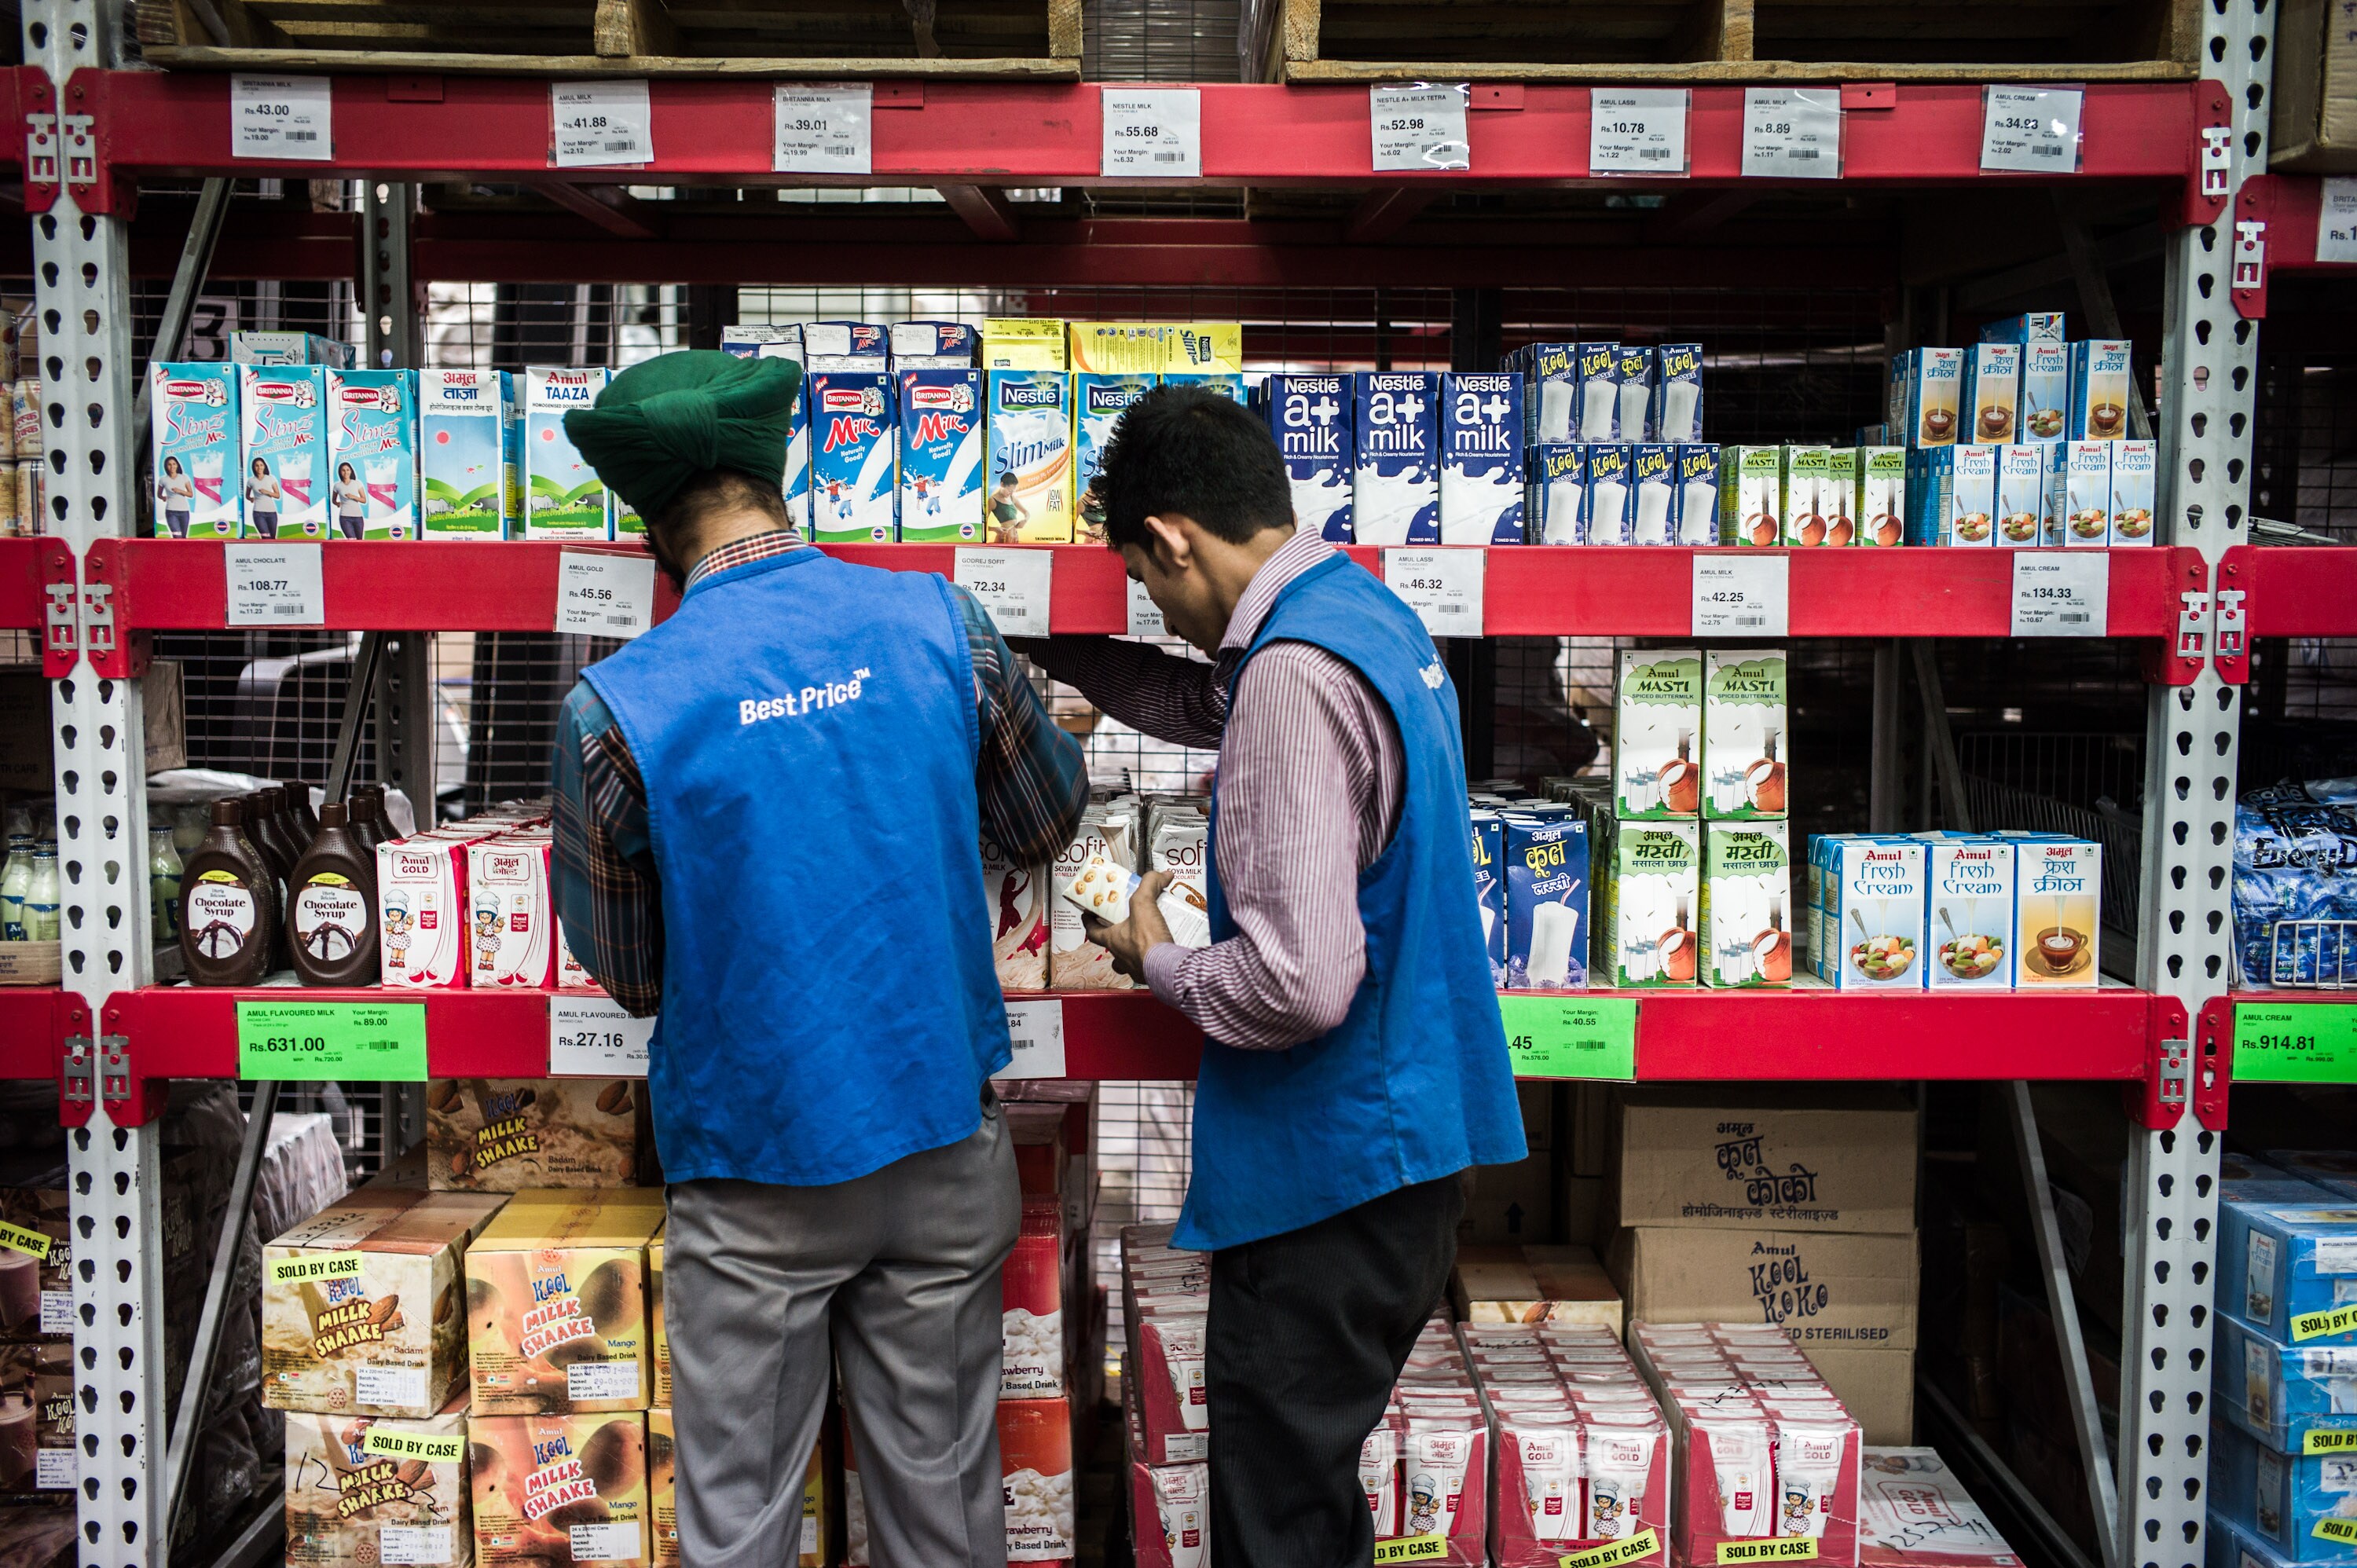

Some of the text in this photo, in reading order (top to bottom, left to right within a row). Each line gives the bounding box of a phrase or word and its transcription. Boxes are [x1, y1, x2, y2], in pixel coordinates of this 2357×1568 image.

[245, 104, 289, 115] Rs.43.00
[563, 117, 607, 129] Rs.41.88
[785, 119, 827, 130] Rs.39.01
[1380, 119, 1424, 130] Rs.52.98
[1601, 123, 1644, 134] Rs.10.78
[1754, 123, 1791, 134] Rs.8.89
[1115, 126, 1158, 137] Rs.55.68
[2035, 354, 2063, 365] Fresh
[2029, 363, 2063, 372] Cream
[443, 372, 477, 386] अमूल
[546, 372, 588, 386] Amul
[167, 384, 204, 395] BRITANNIA
[545, 387, 589, 400] TAAZA
[826, 394, 861, 404] BRITANNIA
[1369, 393, 1424, 424] a+
[824, 415, 881, 453] Milk
[1369, 423, 1425, 450] milk
[841, 445, 866, 456] Naturally
[994, 438, 1065, 474] Slim Milk
[845, 452, 863, 463] Good!
[1546, 452, 1578, 478] KOOL
[1553, 472, 1579, 484] LASSEE
[1049, 489, 1061, 500] LOW
[1049, 501, 1061, 512] FAT
[238, 581, 288, 592] Rs.108.77
[1399, 579, 1442, 589] Rs.46.32
[570, 588, 612, 600] Rs.45.56
[1701, 592, 1743, 603] Rs.42.25
[2022, 588, 2072, 599] Rs.134.33
[1646, 668, 1680, 678] Amul
[1637, 680, 1690, 692] MASTI
[739, 693, 797, 725] Best
[1531, 830, 1561, 842] अमूल
[1732, 830, 1762, 843] अमूल
[1725, 841, 1775, 860] मस्ती
[1864, 850, 1902, 861] Amul
[2046, 847, 2073, 859] अमूल
[400, 855, 429, 865] Amul
[1524, 839, 1567, 878] कूल
[1722, 859, 1779, 870] मसाला छाछ
[1860, 862, 1906, 880] Fresh
[1531, 873, 1571, 896] लस्सी
[1853, 878, 1913, 896] Cream
[2032, 875, 2086, 893] क्रीम
[195, 898, 246, 908] Chocolate
[204, 907, 234, 917] Syrup
[249, 1037, 324, 1053] Rs.631.00
[559, 1032, 623, 1047] Rs.27.16
[2242, 1035, 2315, 1050] Rs.914.81
[478, 1116, 526, 1145] MILLK
[1716, 1121, 1754, 1138] अमूल
[475, 1135, 537, 1168] SHAAKE
[1715, 1134, 1765, 1180] कूल
[1744, 1163, 1818, 1206] कोको
[1751, 1241, 1796, 1255] Amul
[277, 1258, 358, 1279] SOLD BY CASE
[537, 1265, 562, 1274] Amul
[1748, 1256, 1808, 1297] KOOL
[533, 1274, 573, 1302] KOOL
[1759, 1284, 1828, 1324] KOKO
[524, 1297, 581, 1333] MILLK
[522, 1318, 594, 1358] SHAAKE
[1805, 1328, 1889, 1340] STERILISED
[607, 1339, 636, 1349] Mango
[393, 1346, 423, 1355] Badam
[366, 1358, 387, 1368] Dairy
[1527, 1452, 1554, 1461] GOLD
[1726, 1541, 1811, 1559] SOLD BY CASE
